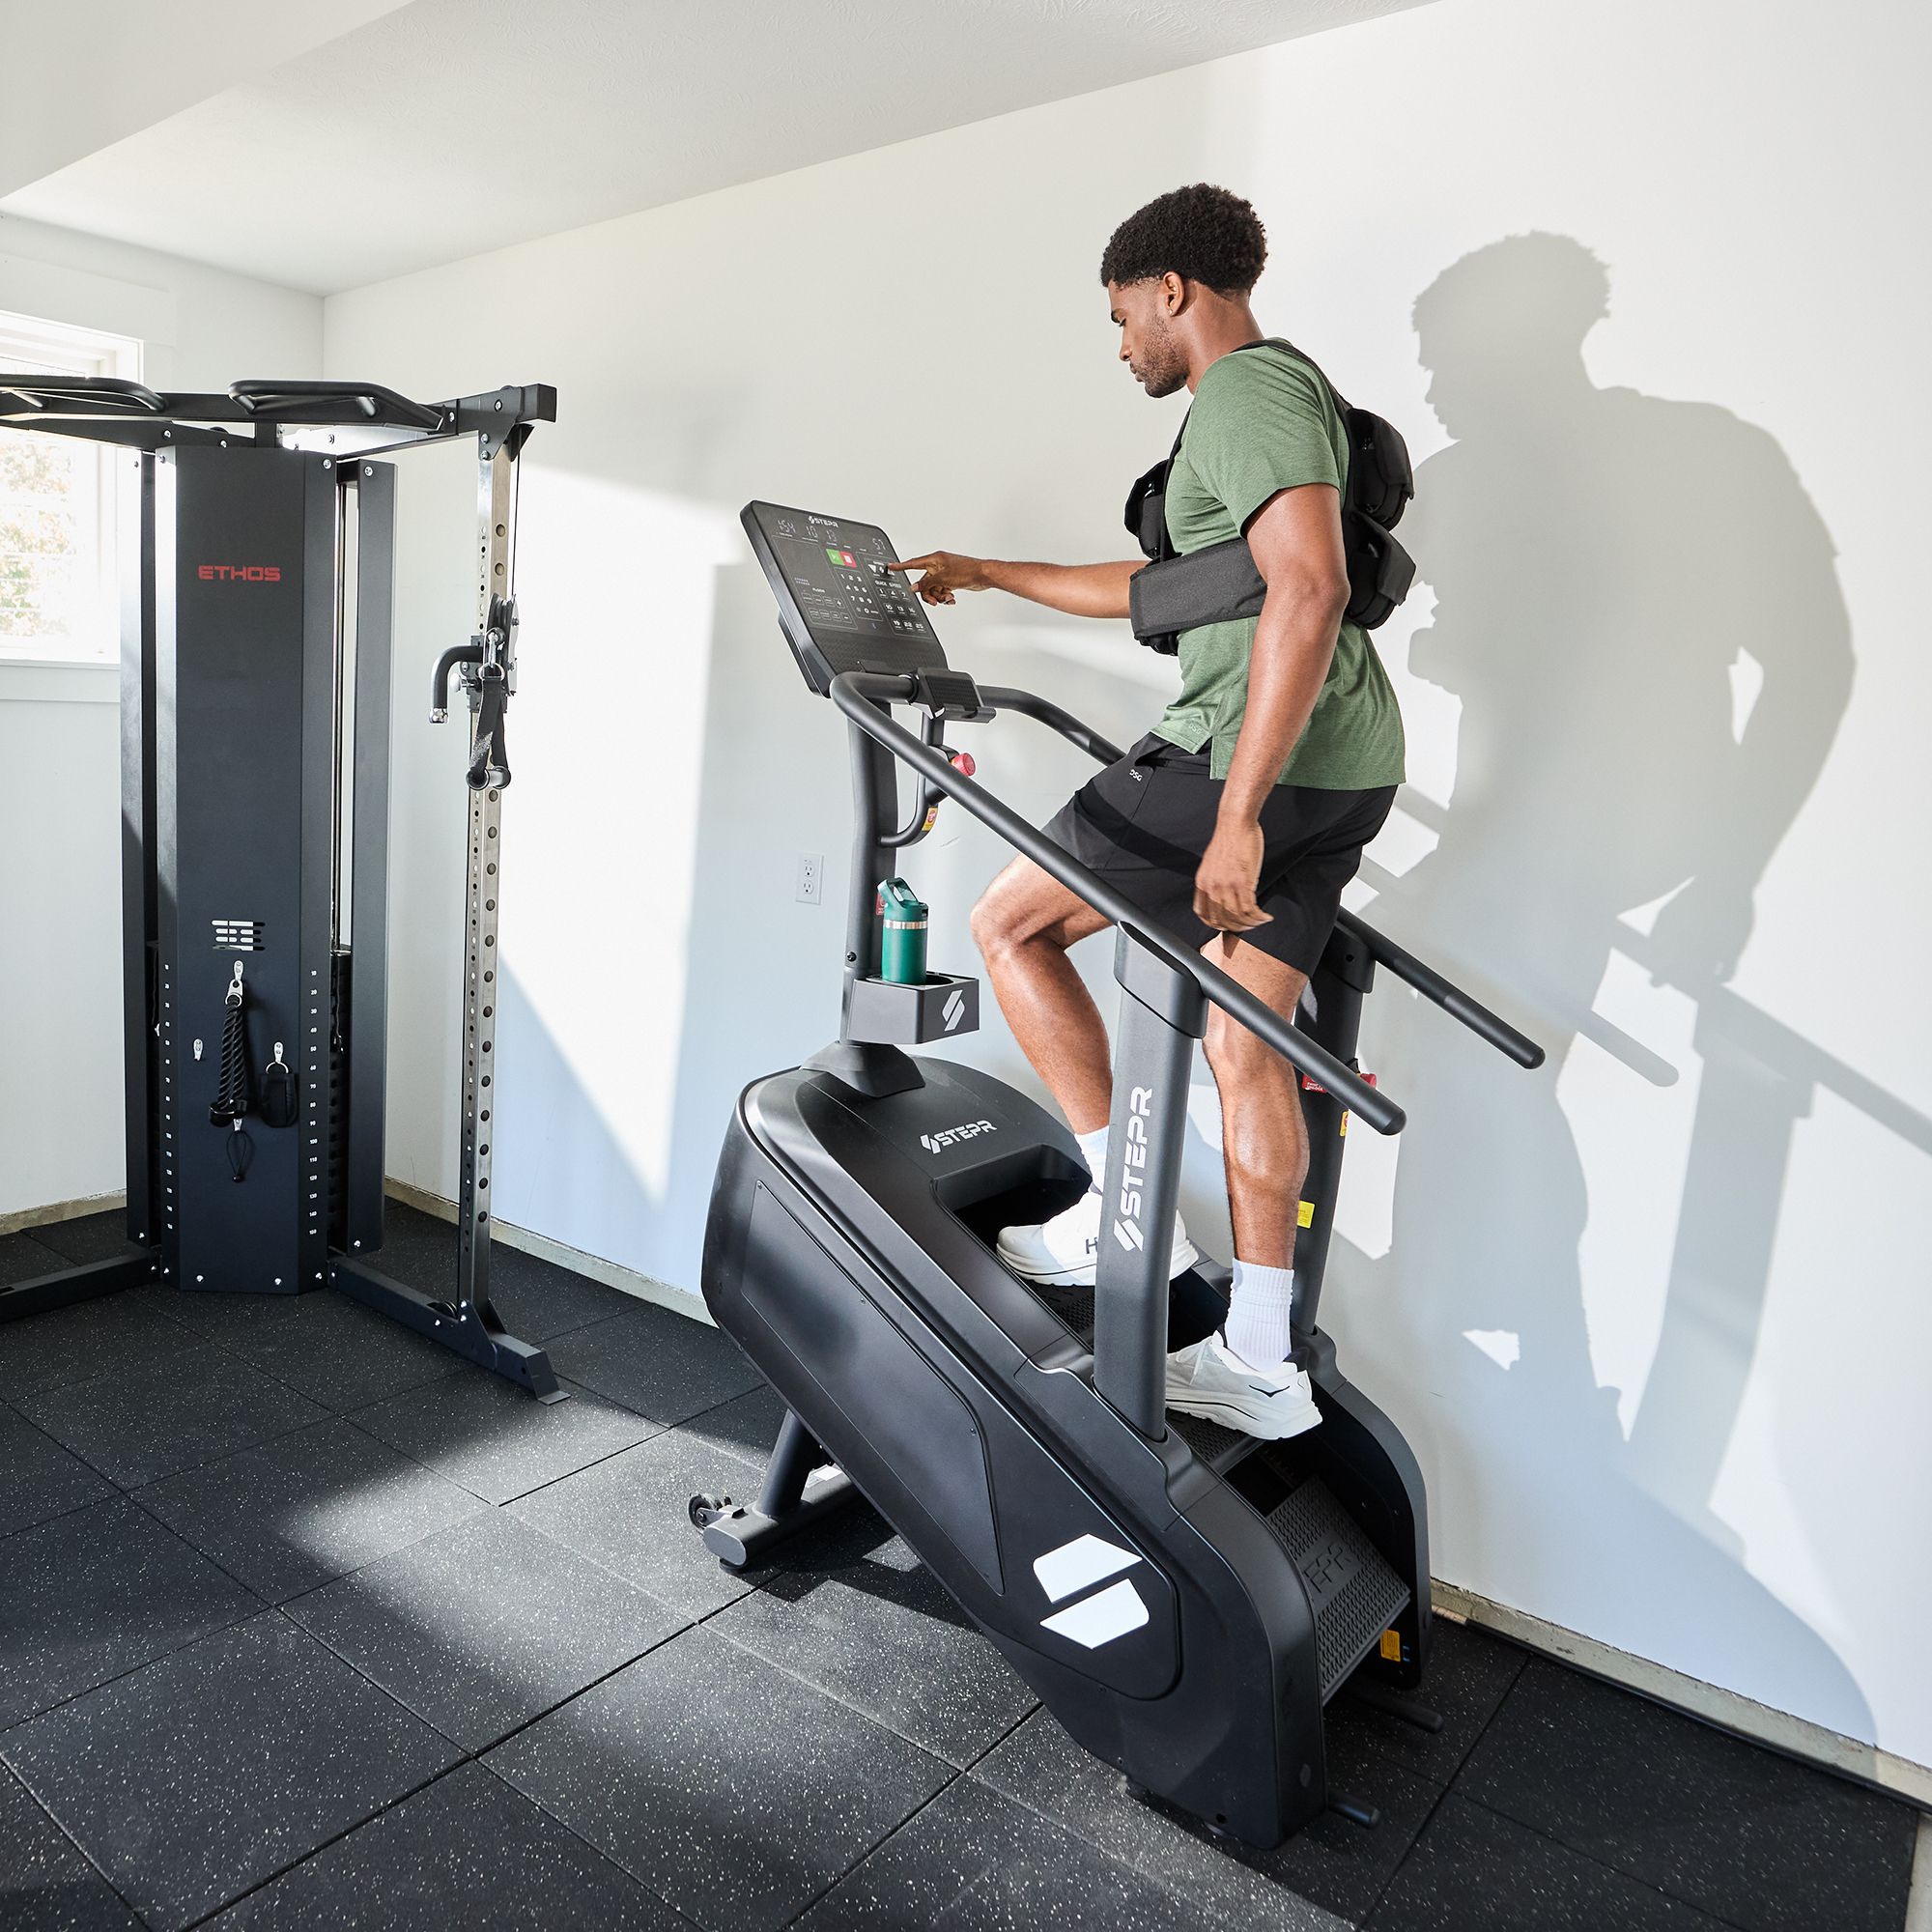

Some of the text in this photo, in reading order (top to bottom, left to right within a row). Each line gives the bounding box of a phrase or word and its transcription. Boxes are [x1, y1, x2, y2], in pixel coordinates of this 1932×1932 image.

[198, 565, 281, 582] ETHOS
[933, 1120, 998, 1147] STEPR
[1120, 1087, 1152, 1219] STEPR
